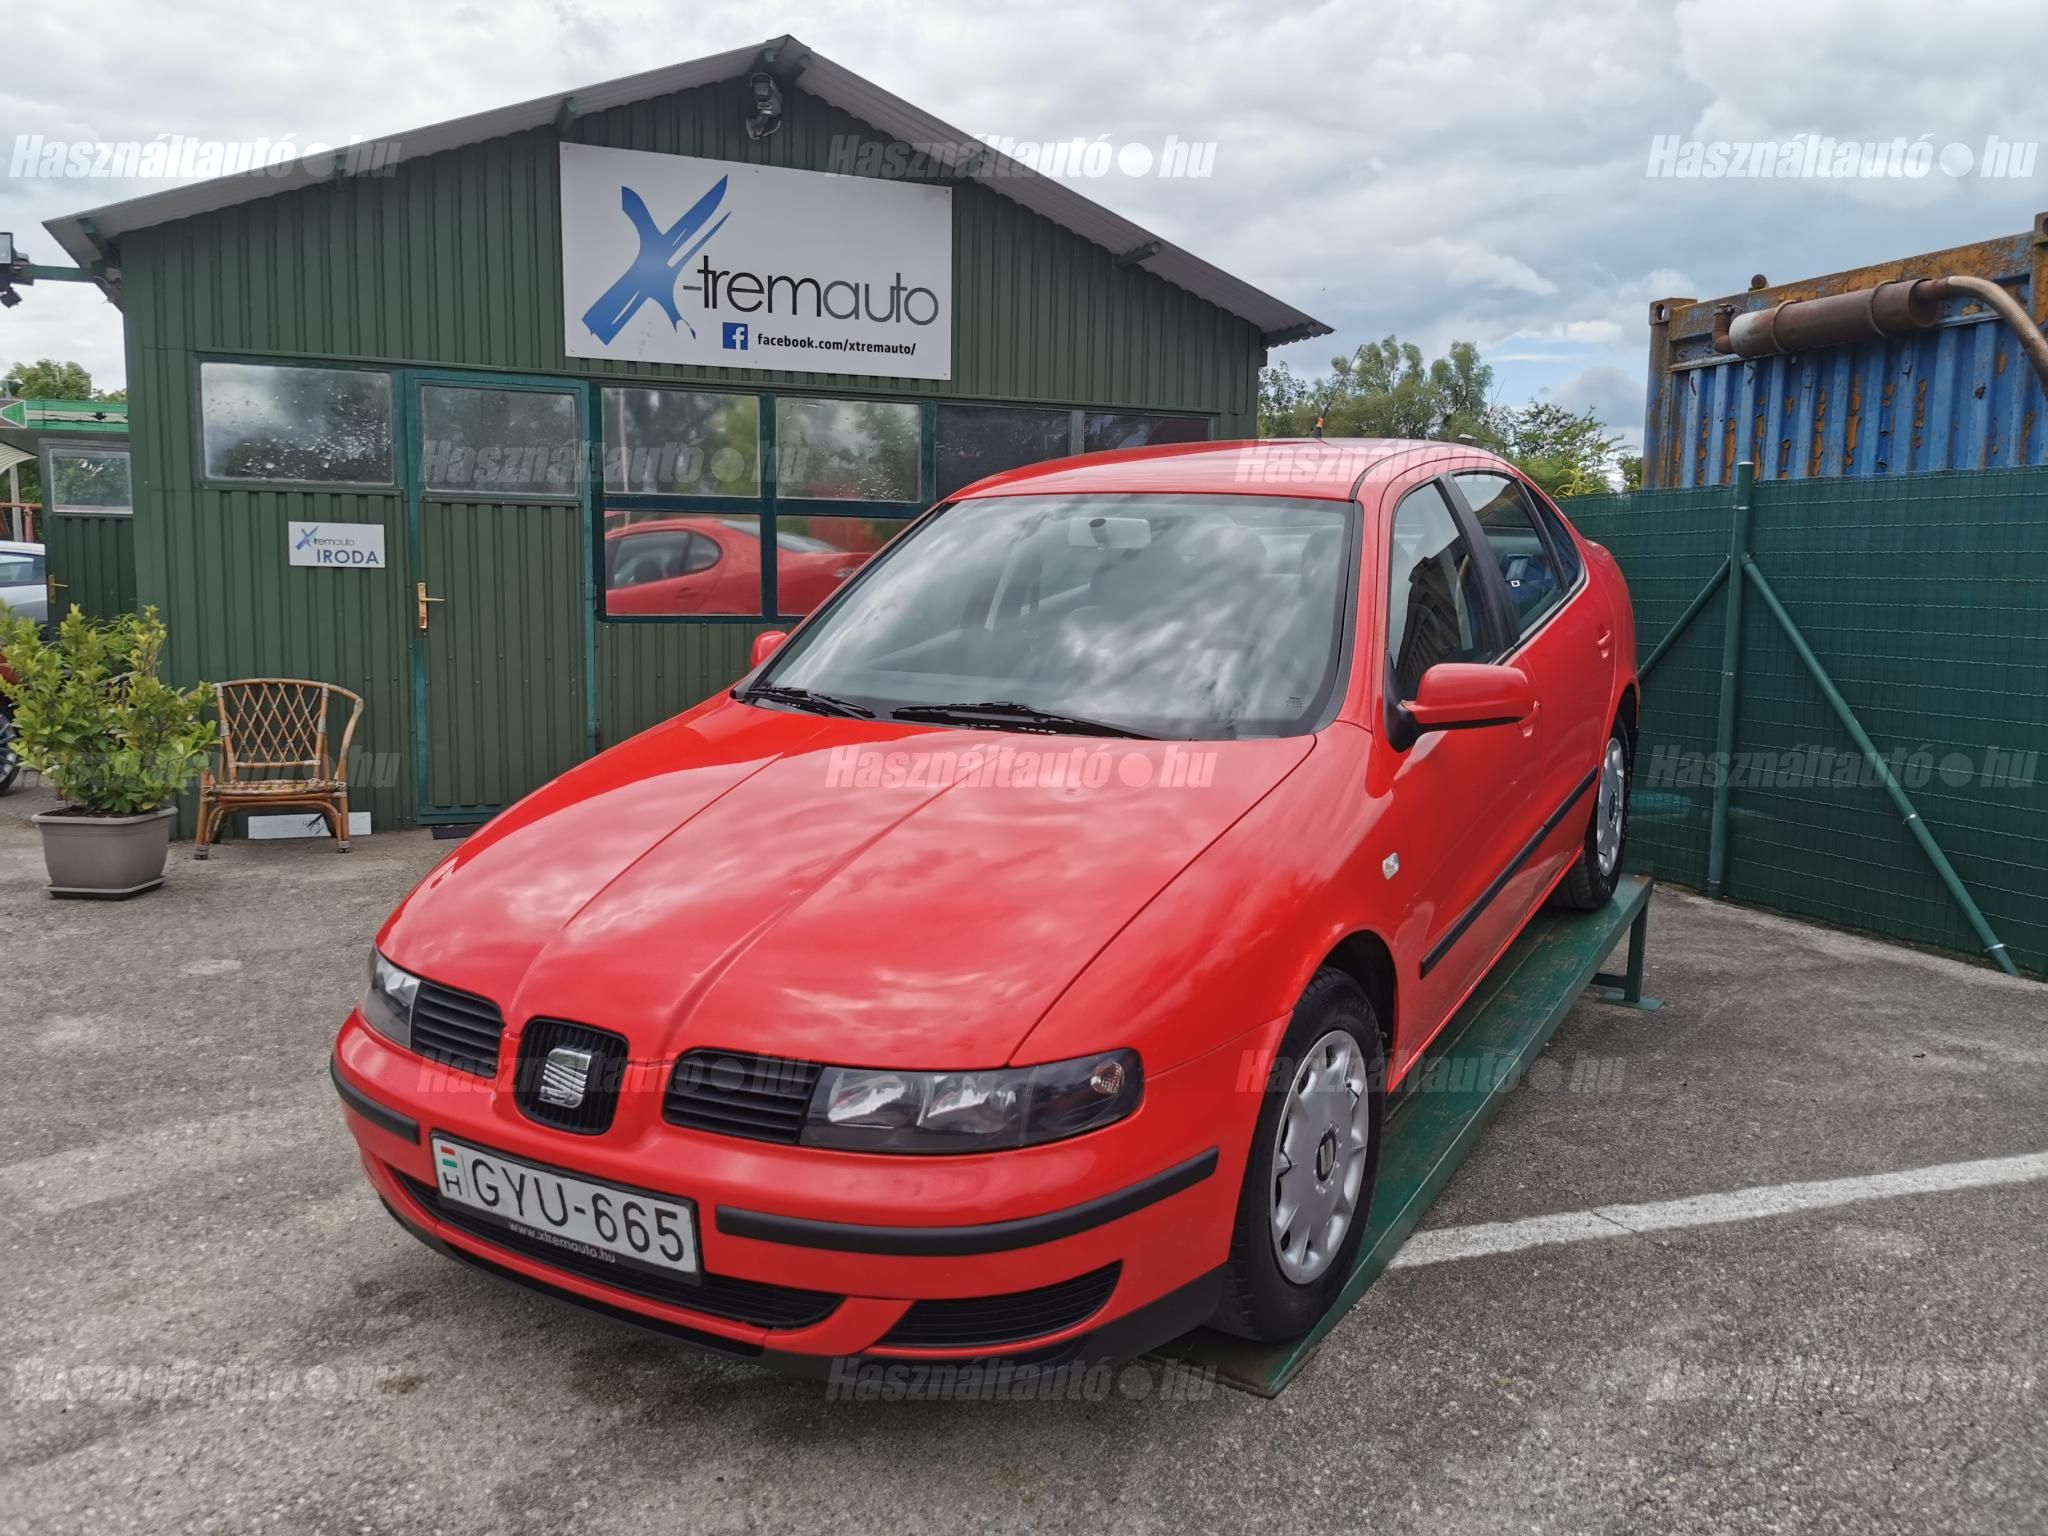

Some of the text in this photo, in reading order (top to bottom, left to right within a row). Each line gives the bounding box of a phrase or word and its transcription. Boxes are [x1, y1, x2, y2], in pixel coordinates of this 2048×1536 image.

[757, 332, 917, 356] facebook.com/xtremauto/
[316, 549, 379, 564] IRODA
[471, 1158, 685, 1262] GYU-665
[508, 1220, 616, 1264] www.xtremauto.hu
